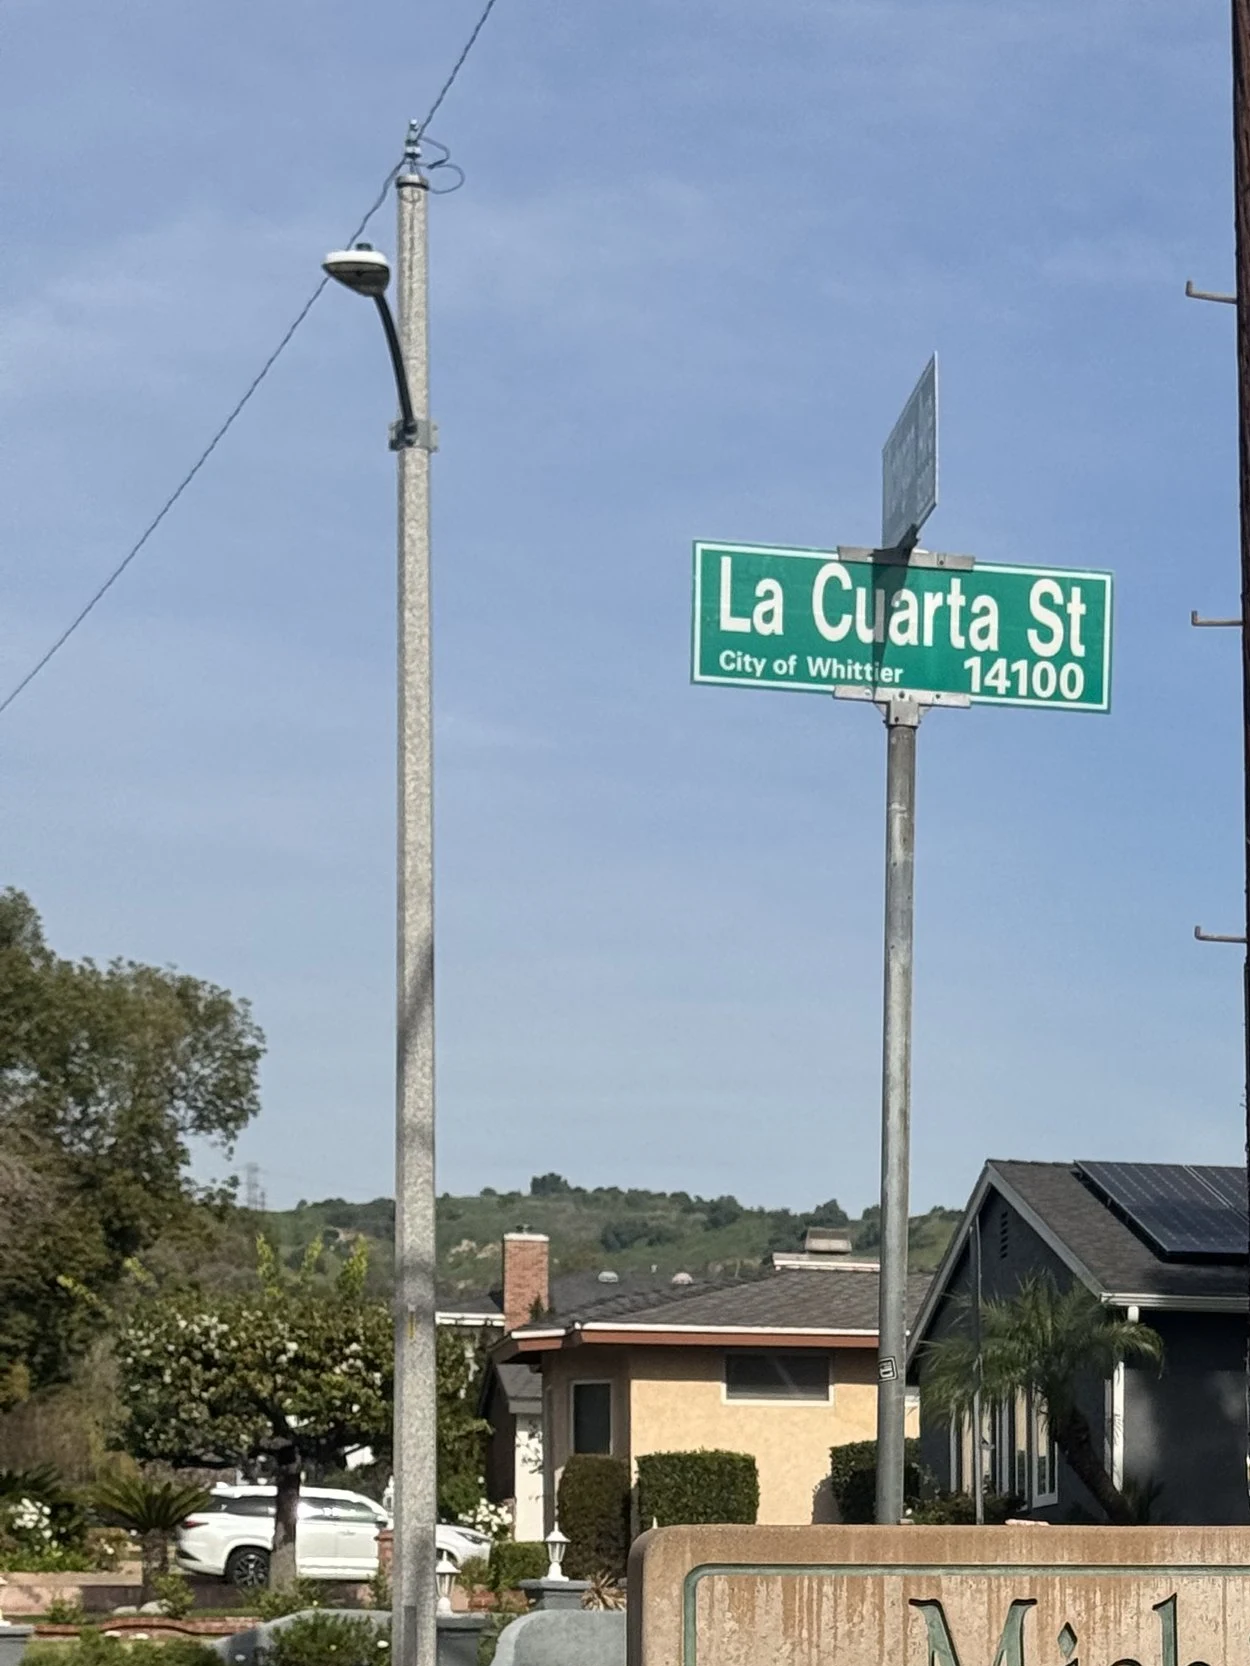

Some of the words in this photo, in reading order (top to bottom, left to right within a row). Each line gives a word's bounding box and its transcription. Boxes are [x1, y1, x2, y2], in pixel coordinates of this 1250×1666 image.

[719, 556, 784, 636] La
[812, 561, 999, 653] Cuarta
[1027, 579, 1086, 658] St
[719, 649, 767, 677] City
[773, 655, 798, 677] of
[807, 656, 903, 684] Whittier
[964, 656, 1084, 700] 14100
